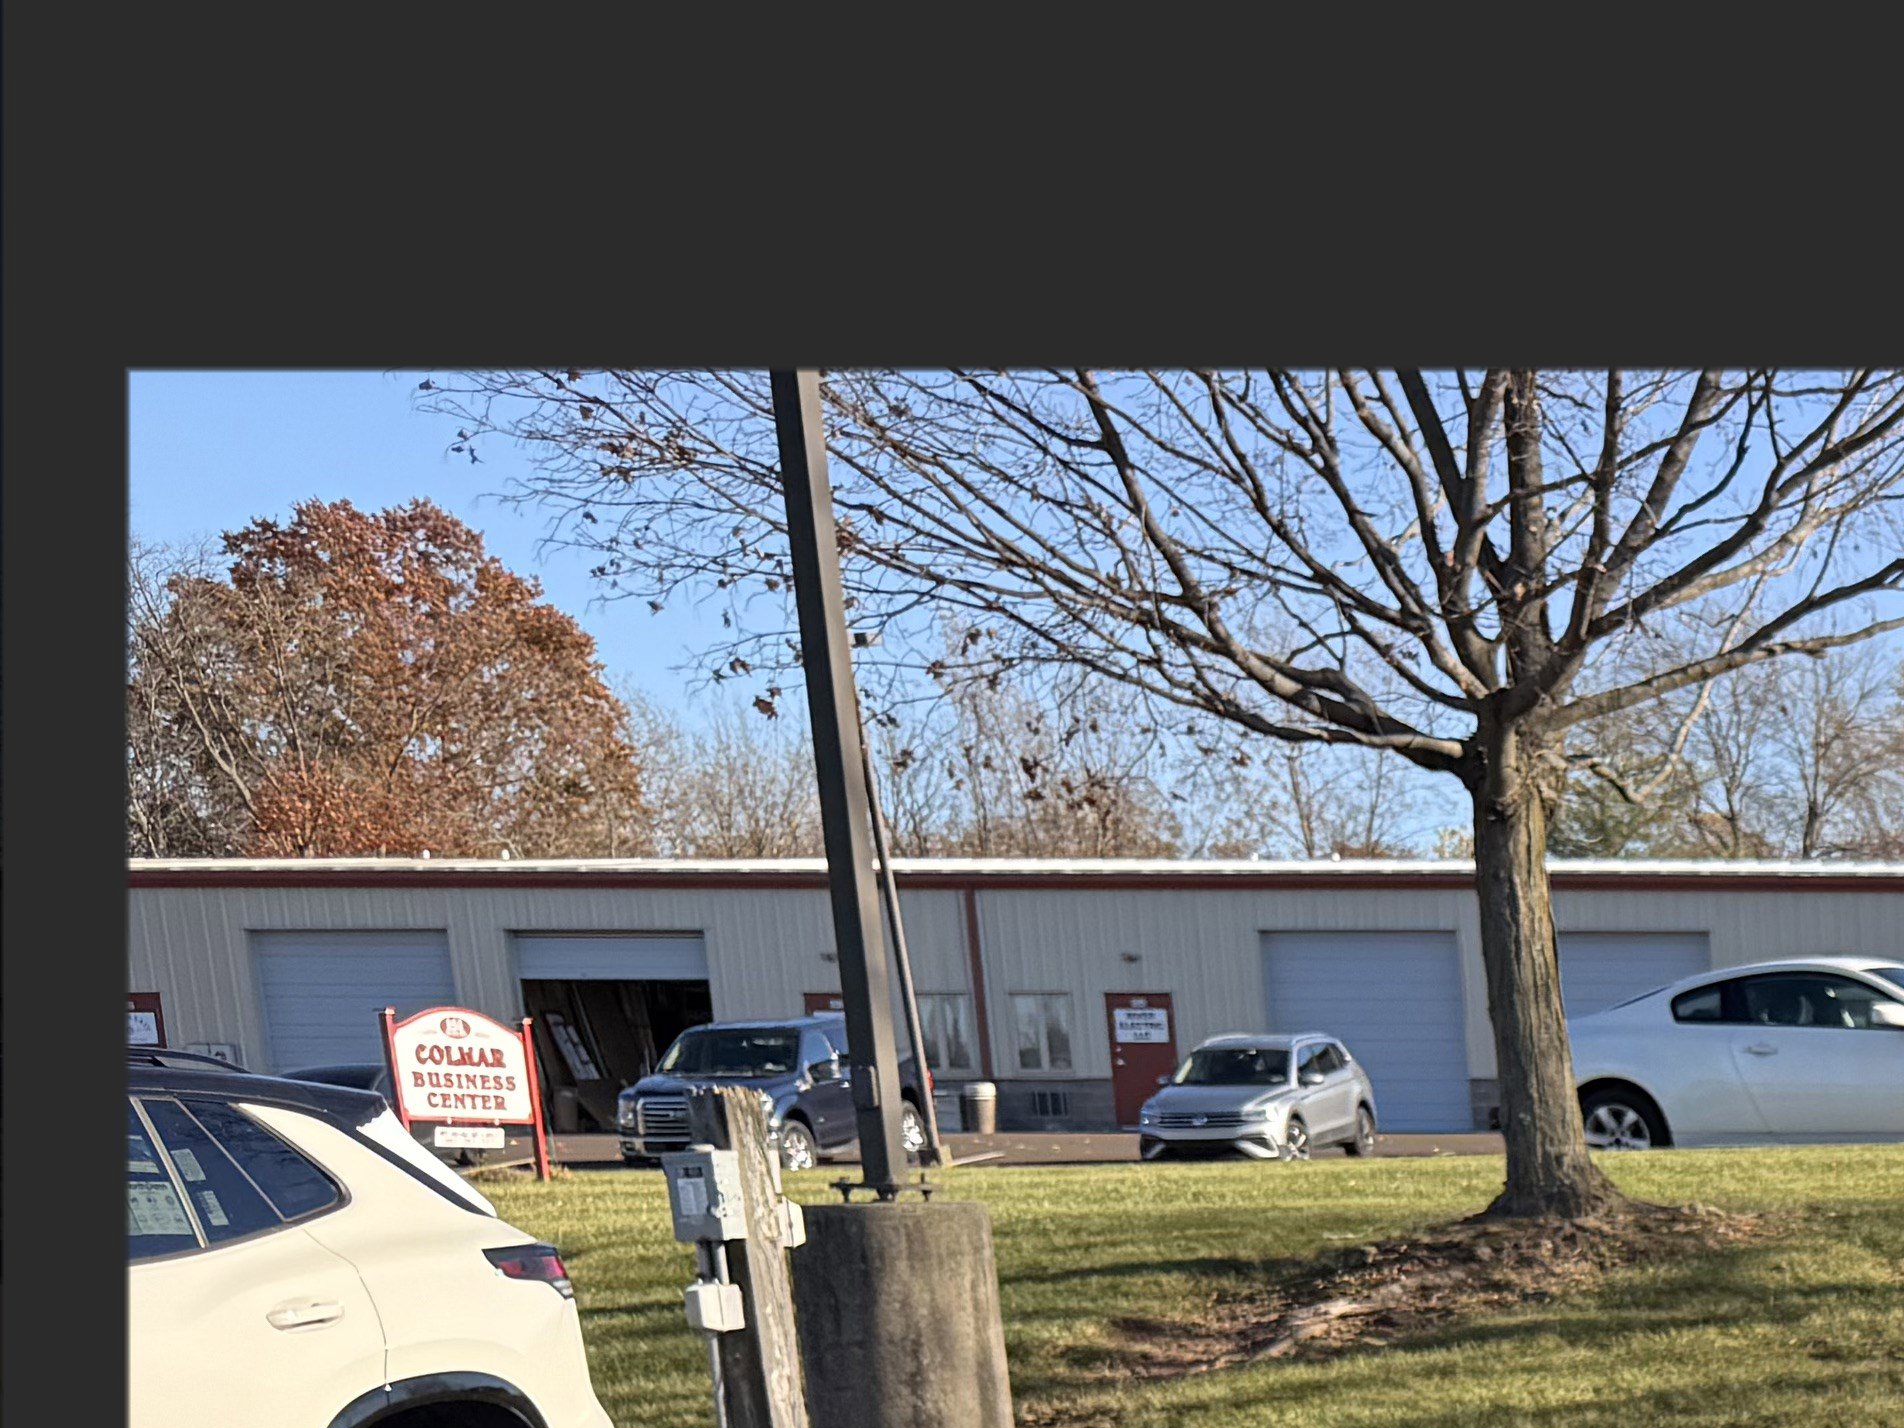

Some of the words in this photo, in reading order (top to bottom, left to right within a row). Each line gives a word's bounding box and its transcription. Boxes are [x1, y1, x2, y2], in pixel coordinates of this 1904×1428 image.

[415, 1043, 506, 1068] COLMAR
[412, 1071, 516, 1091] BUSINESS
[427, 1092, 507, 1111] CENTER
